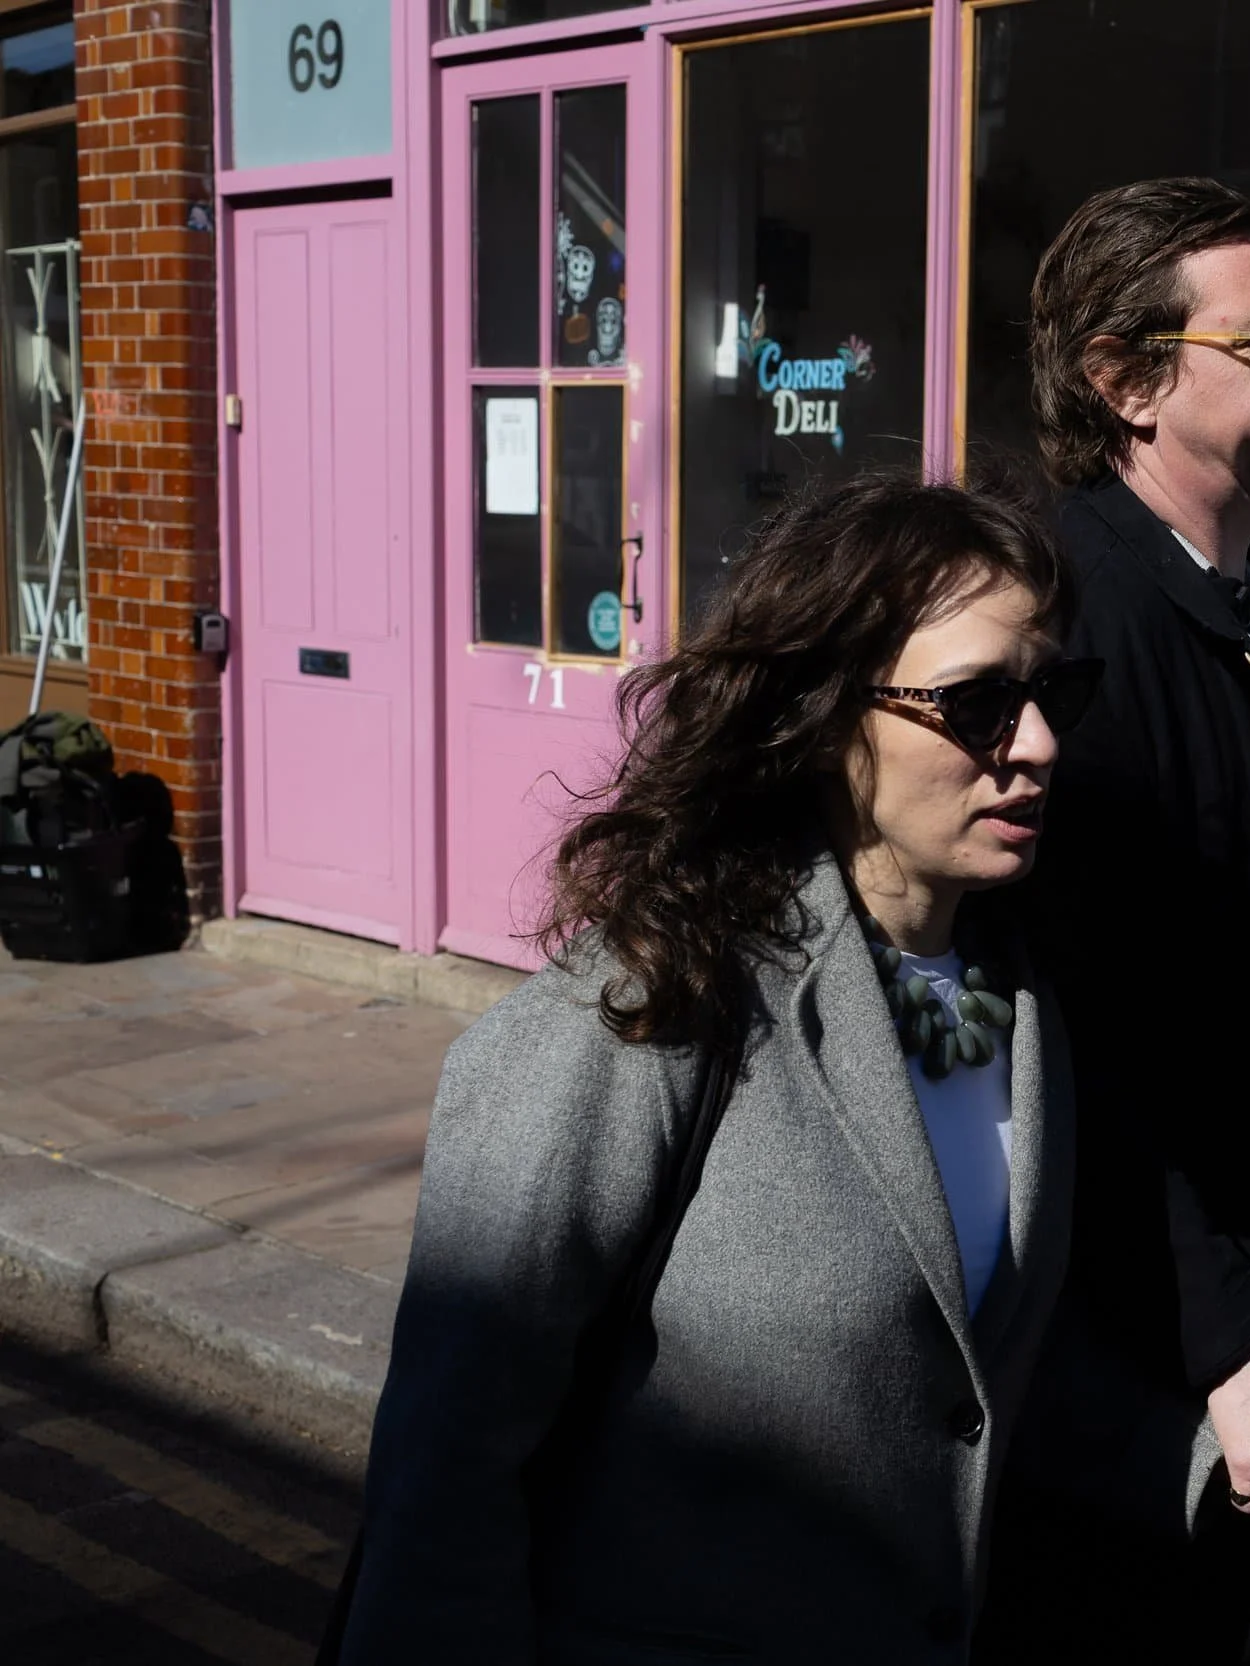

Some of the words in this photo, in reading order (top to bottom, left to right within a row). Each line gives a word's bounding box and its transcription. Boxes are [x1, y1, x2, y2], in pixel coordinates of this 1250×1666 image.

[289, 19, 344, 93] 69
[758, 342, 846, 391] CORNER
[772, 389, 838, 435] DELI
[523, 662, 566, 709] 71
